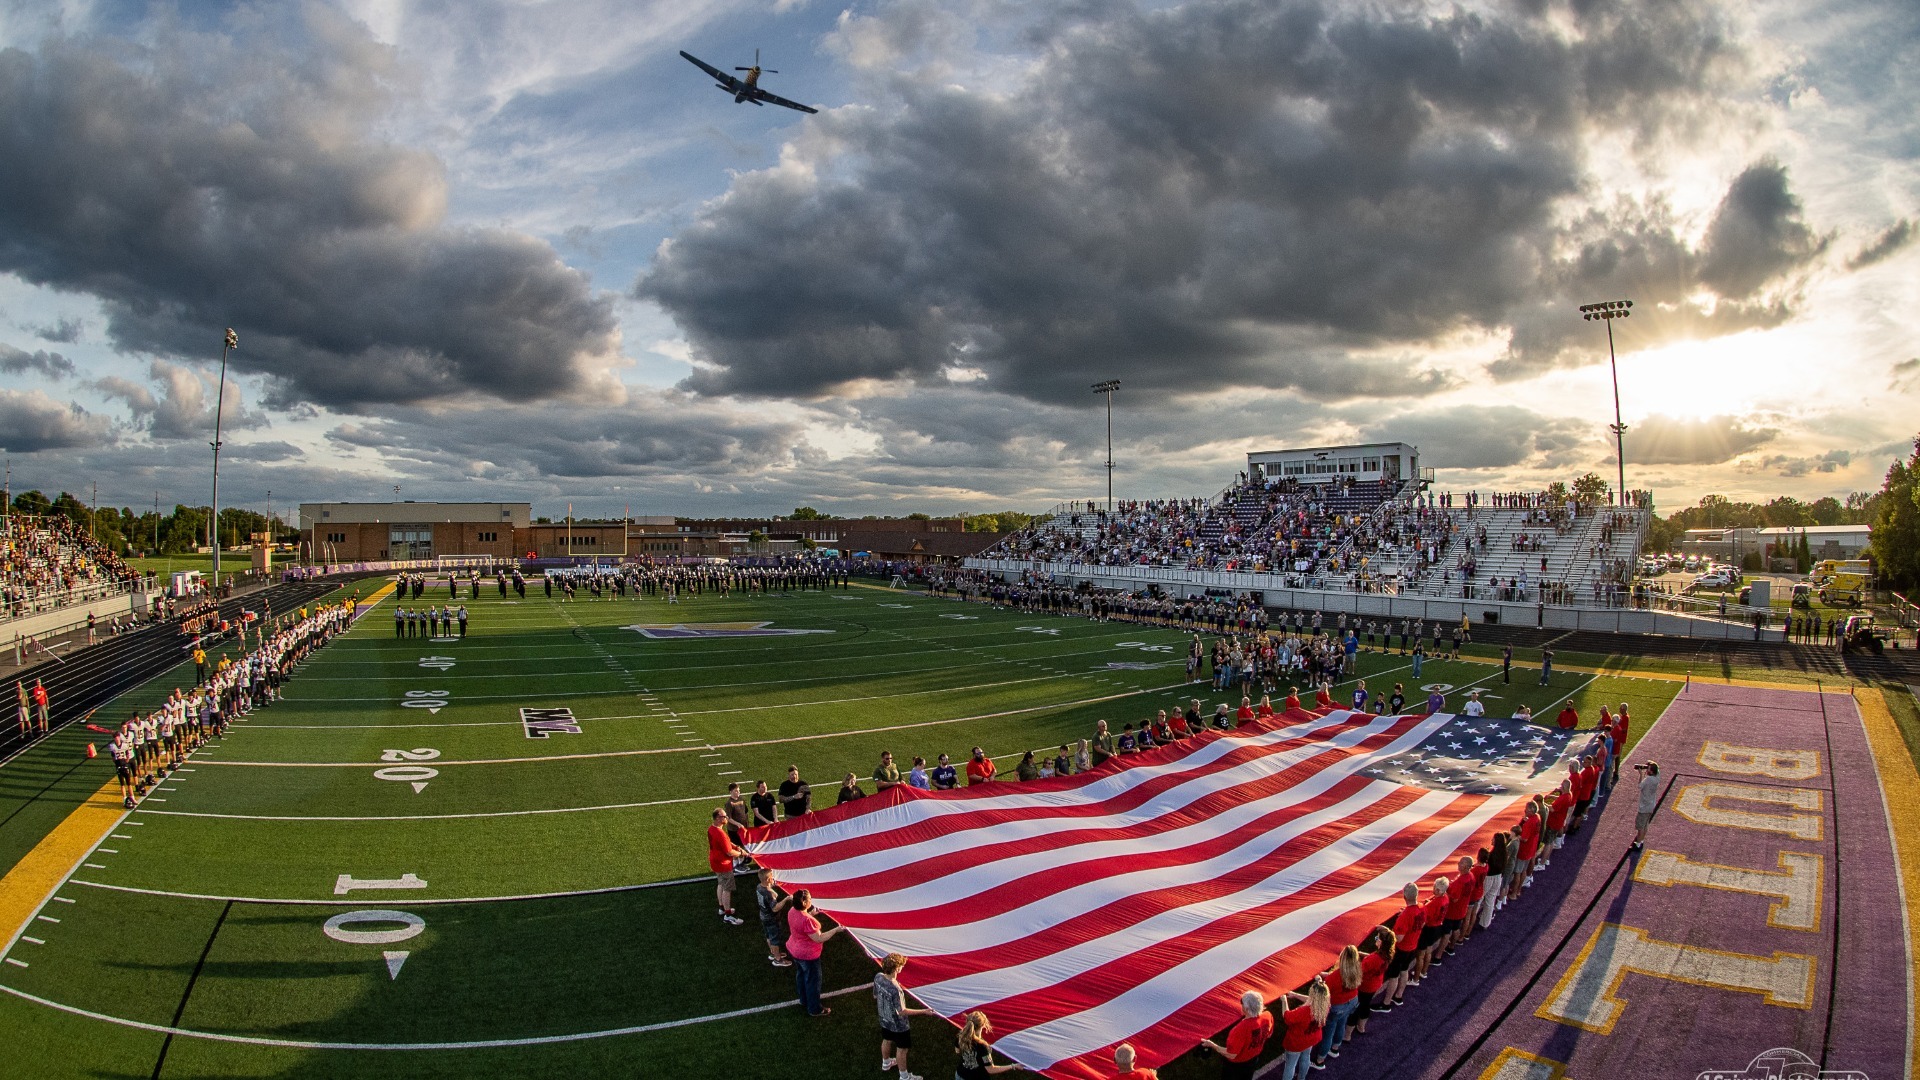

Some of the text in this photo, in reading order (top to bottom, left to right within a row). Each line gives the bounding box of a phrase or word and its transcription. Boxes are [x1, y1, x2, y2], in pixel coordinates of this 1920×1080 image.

[391, 560, 417, 570] HOME
[421, 559, 432, 568] OF
[527, 551, 537, 559] 25
[400, 690, 450, 708] 30
[519, 707, 583, 739] MVL
[373, 747, 442, 782] 20
[323, 873, 428, 944] 10
[1477, 740, 1824, 1080] BUTL
